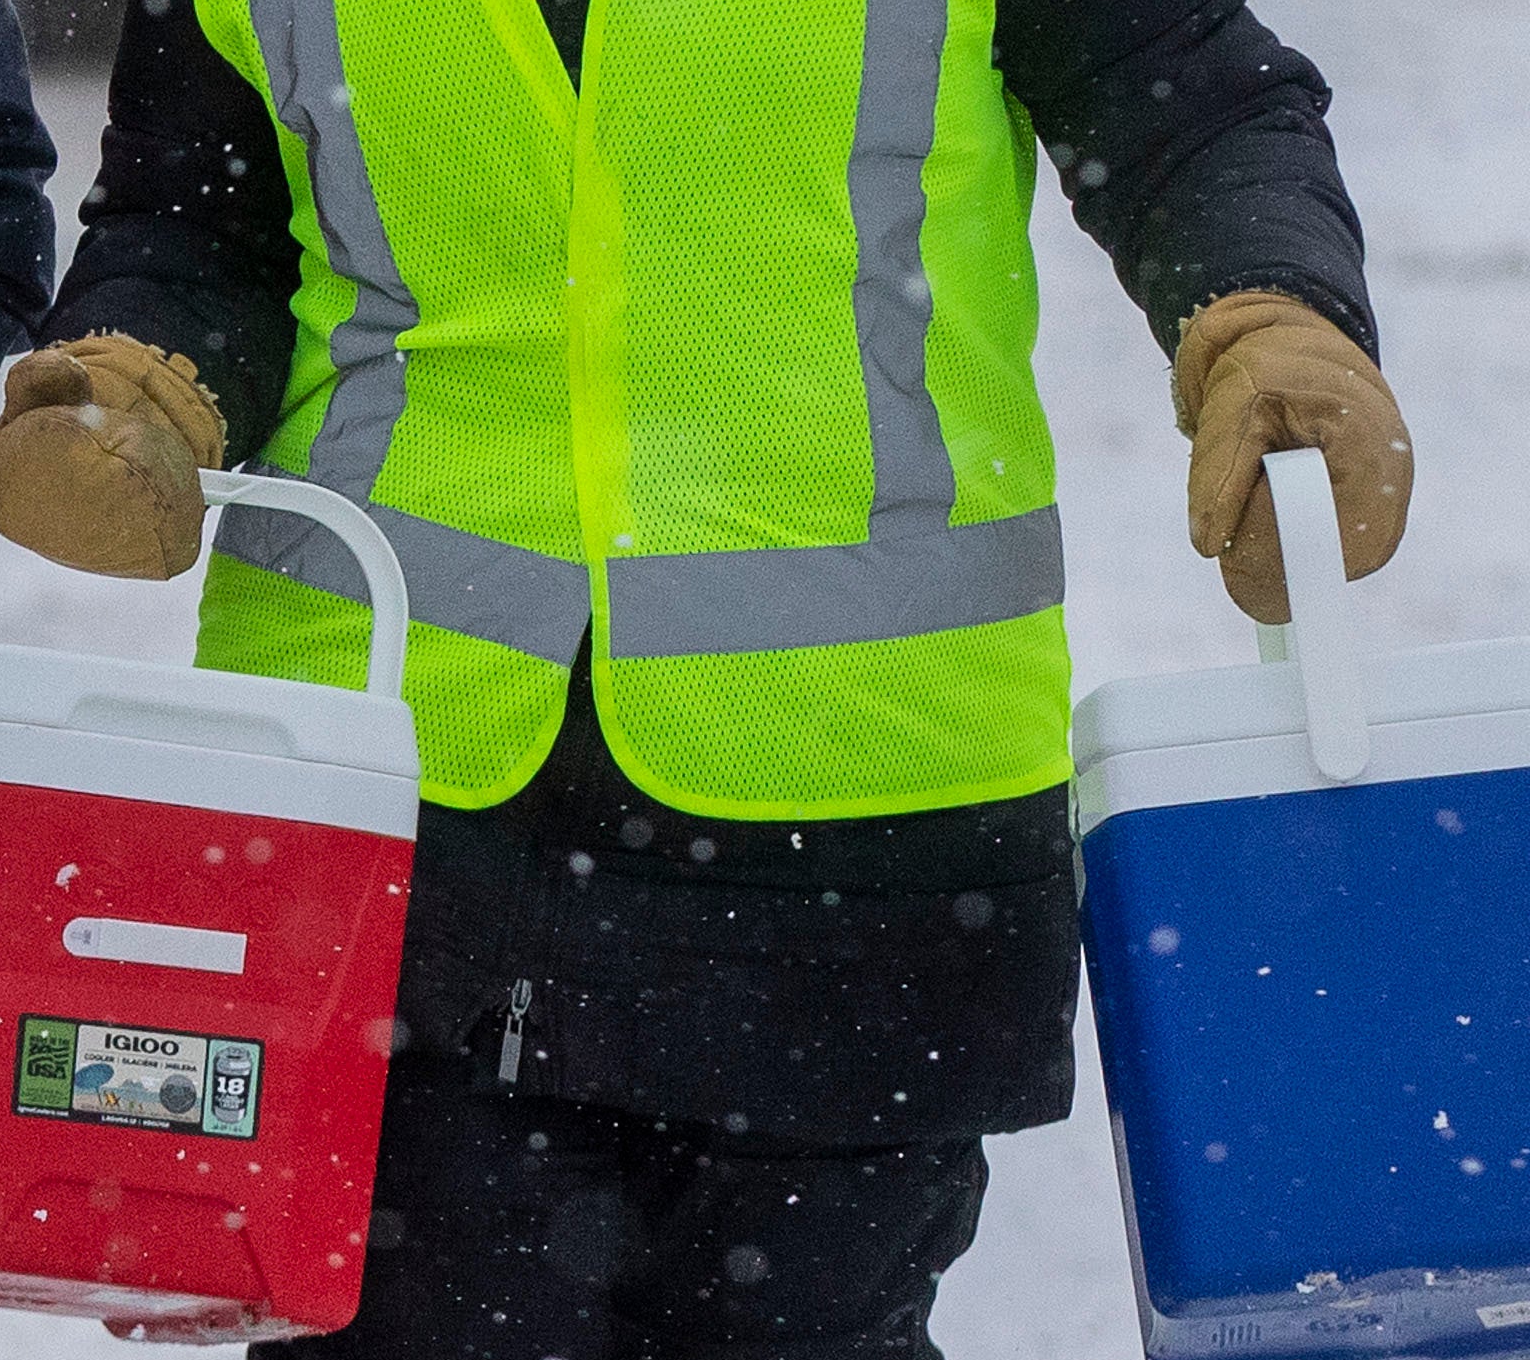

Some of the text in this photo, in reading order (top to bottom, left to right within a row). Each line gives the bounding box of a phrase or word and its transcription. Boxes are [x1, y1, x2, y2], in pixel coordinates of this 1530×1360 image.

[104, 1033, 179, 1056] IGLOO
[84, 1052, 115, 1063] COOLER
[217, 1076, 245, 1095] 18
